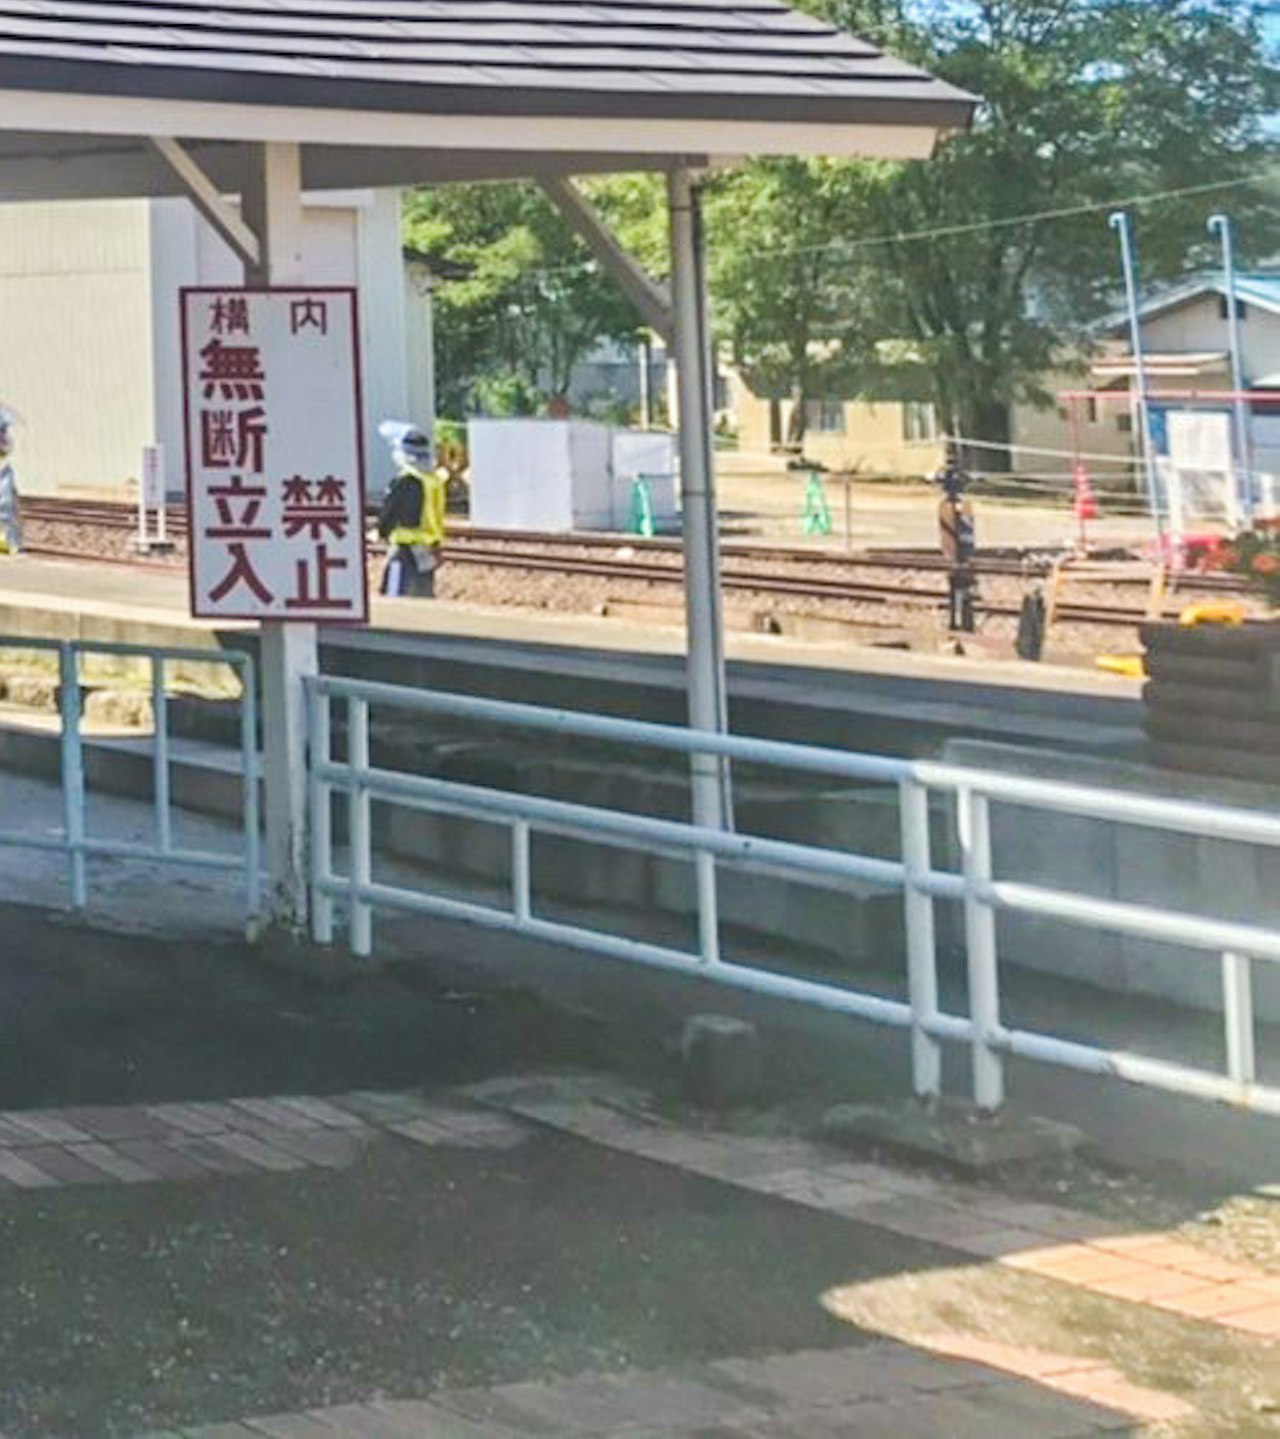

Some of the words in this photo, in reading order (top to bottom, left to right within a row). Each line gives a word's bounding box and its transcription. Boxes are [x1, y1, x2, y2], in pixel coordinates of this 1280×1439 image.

[198, 337, 275, 607] 無断立入
[280, 474, 354, 610] 禁止
